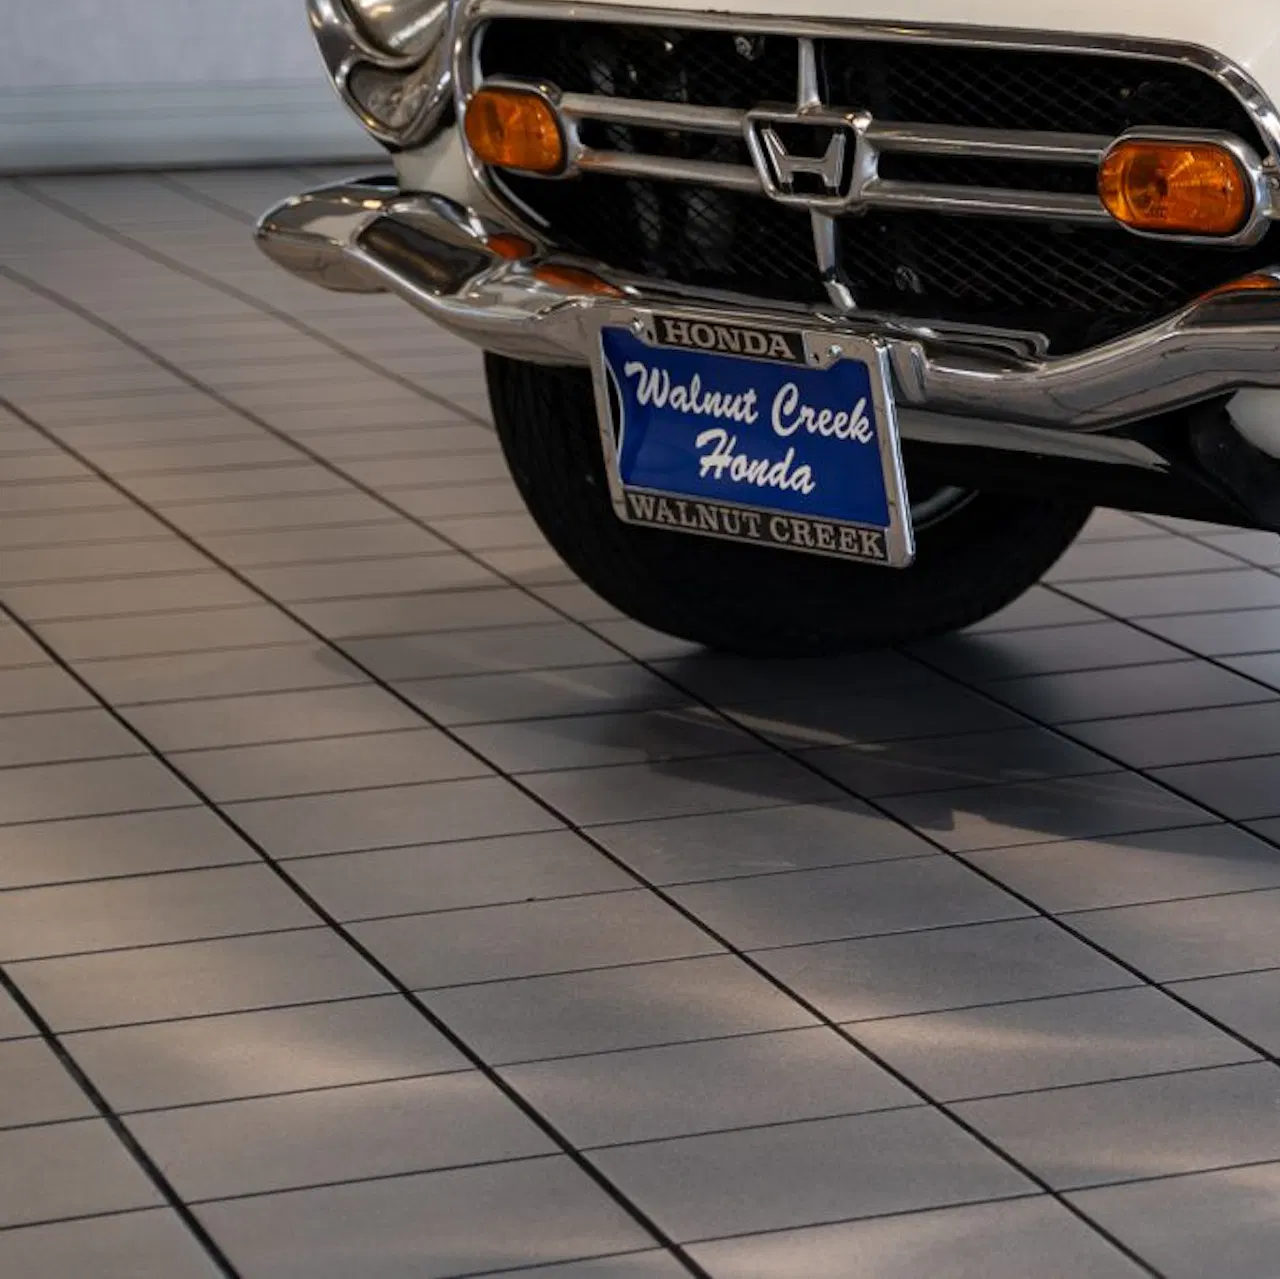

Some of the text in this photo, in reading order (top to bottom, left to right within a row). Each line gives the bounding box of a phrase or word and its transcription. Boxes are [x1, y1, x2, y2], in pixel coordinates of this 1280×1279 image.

[665, 319, 796, 360] HONDA
[625, 361, 873, 444] Walnut Creek
[696, 428, 816, 495] Honda
[628, 493, 886, 559] WALNUT CREEK
